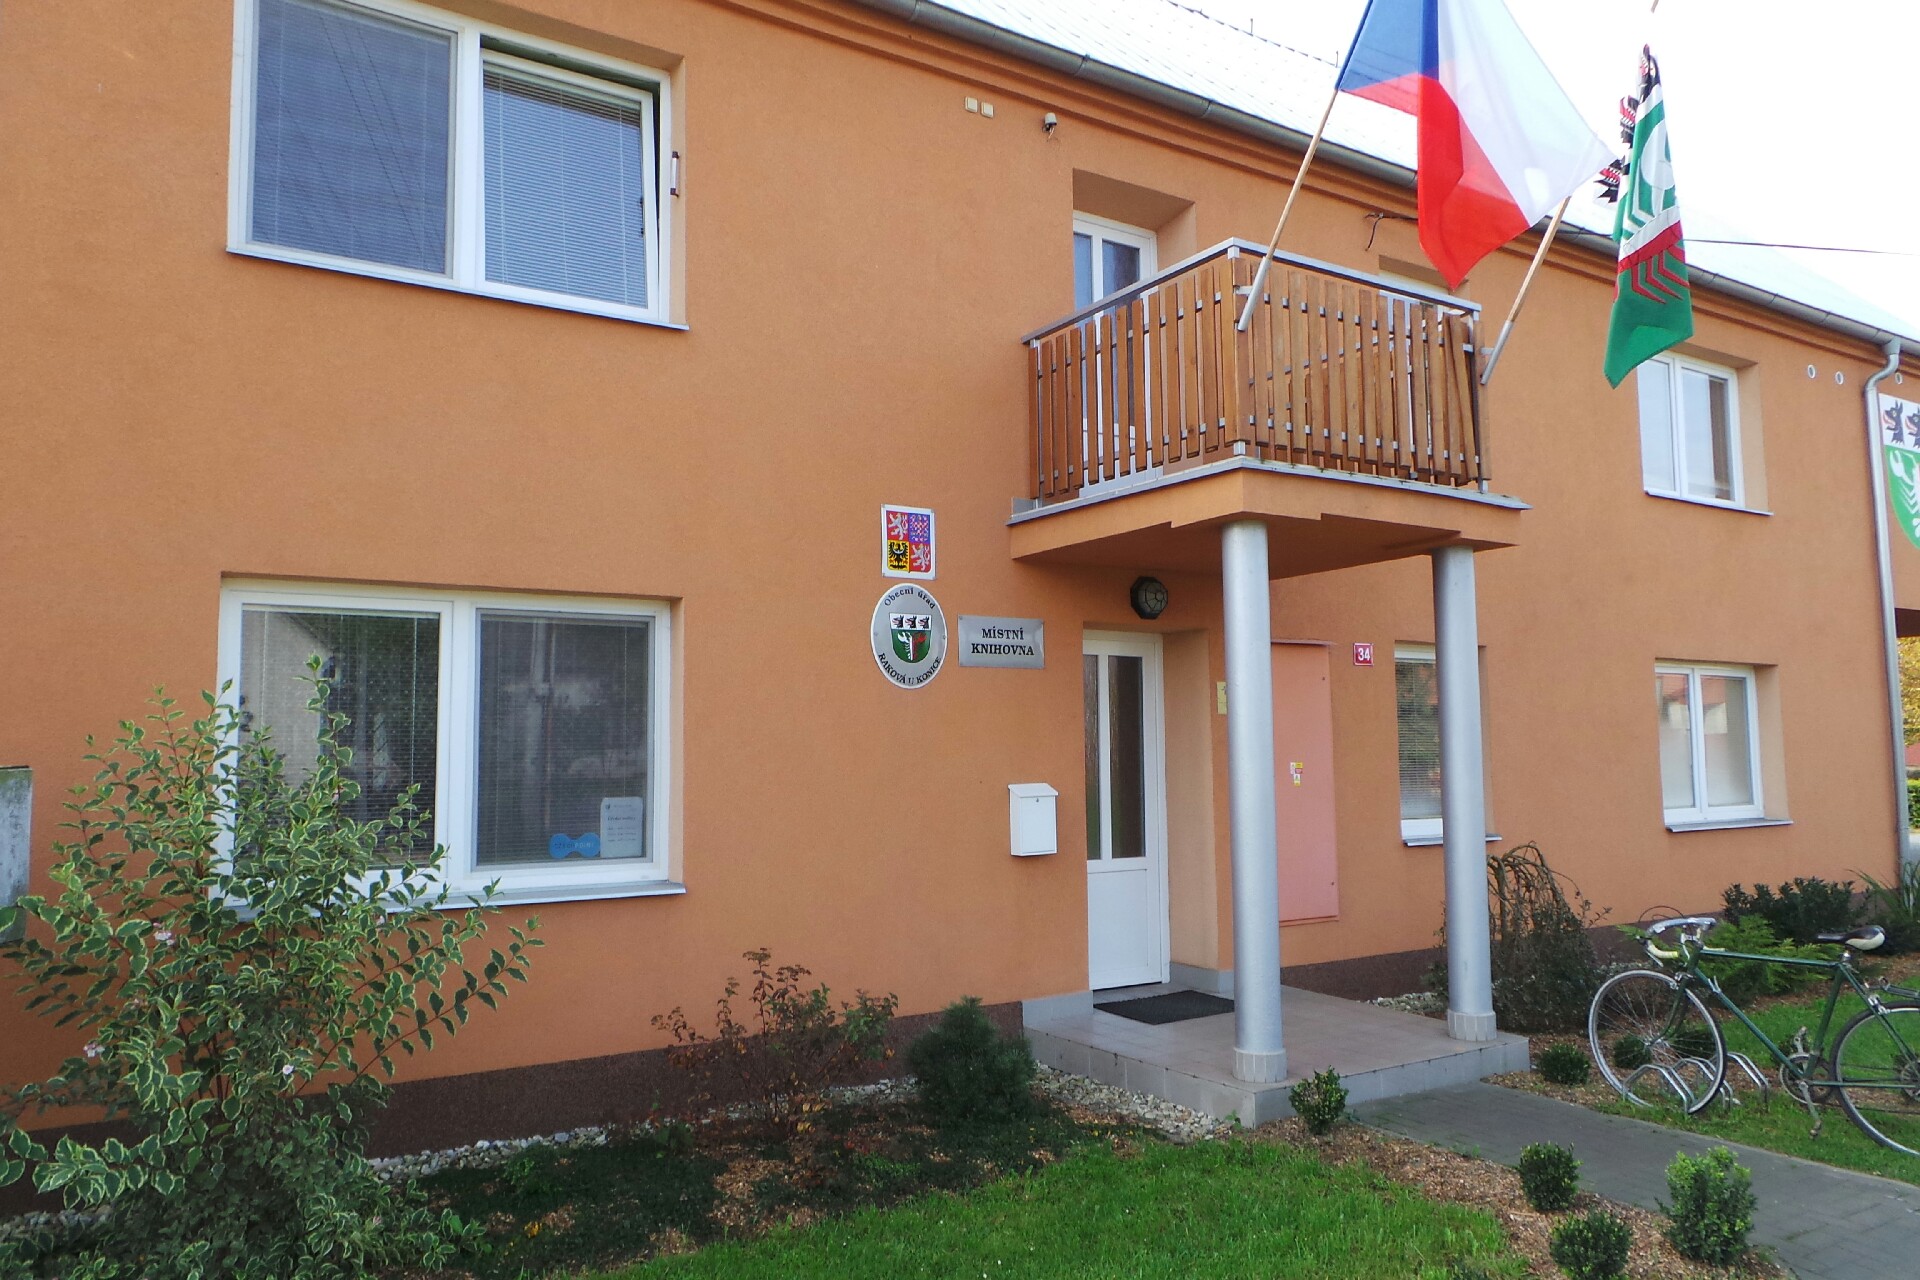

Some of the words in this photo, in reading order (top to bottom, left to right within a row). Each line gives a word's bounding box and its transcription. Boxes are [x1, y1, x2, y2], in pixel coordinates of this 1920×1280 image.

[884, 587, 914, 607] Obecní
[917, 590, 936, 610] úřad
[981, 625, 1024, 640] MÍSTNÍ
[971, 643, 1035, 656] KNIHOVNA
[1358, 647, 1371, 661] 34
[878, 652, 907, 684] RAKOVÁ
[916, 656, 942, 685] KONICE
